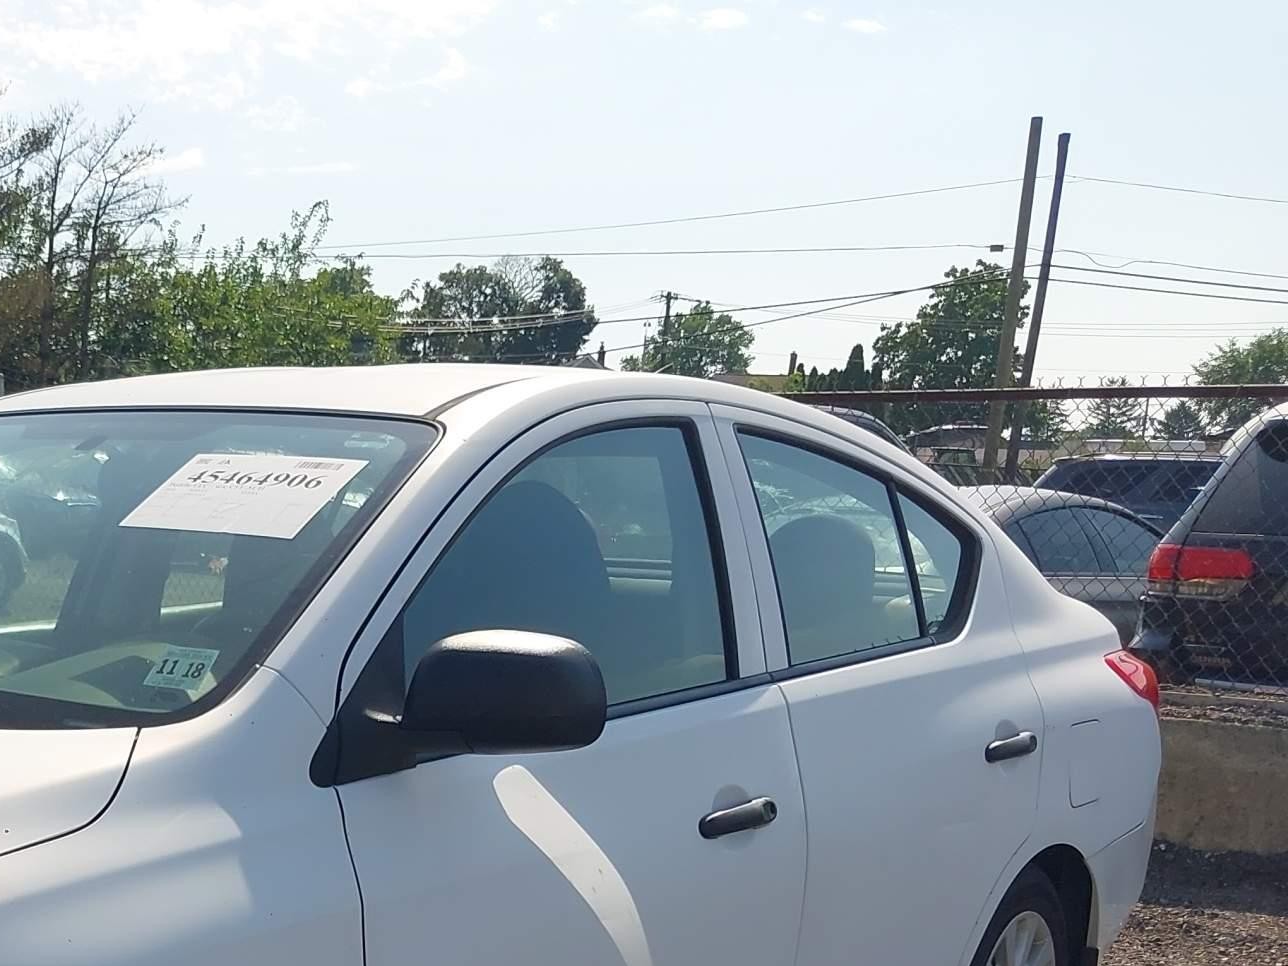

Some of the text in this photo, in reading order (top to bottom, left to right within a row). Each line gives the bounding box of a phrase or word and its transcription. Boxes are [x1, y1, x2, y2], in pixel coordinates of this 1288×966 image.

[188, 470, 328, 489] 45464906
[156, 658, 206, 679] 11 18
